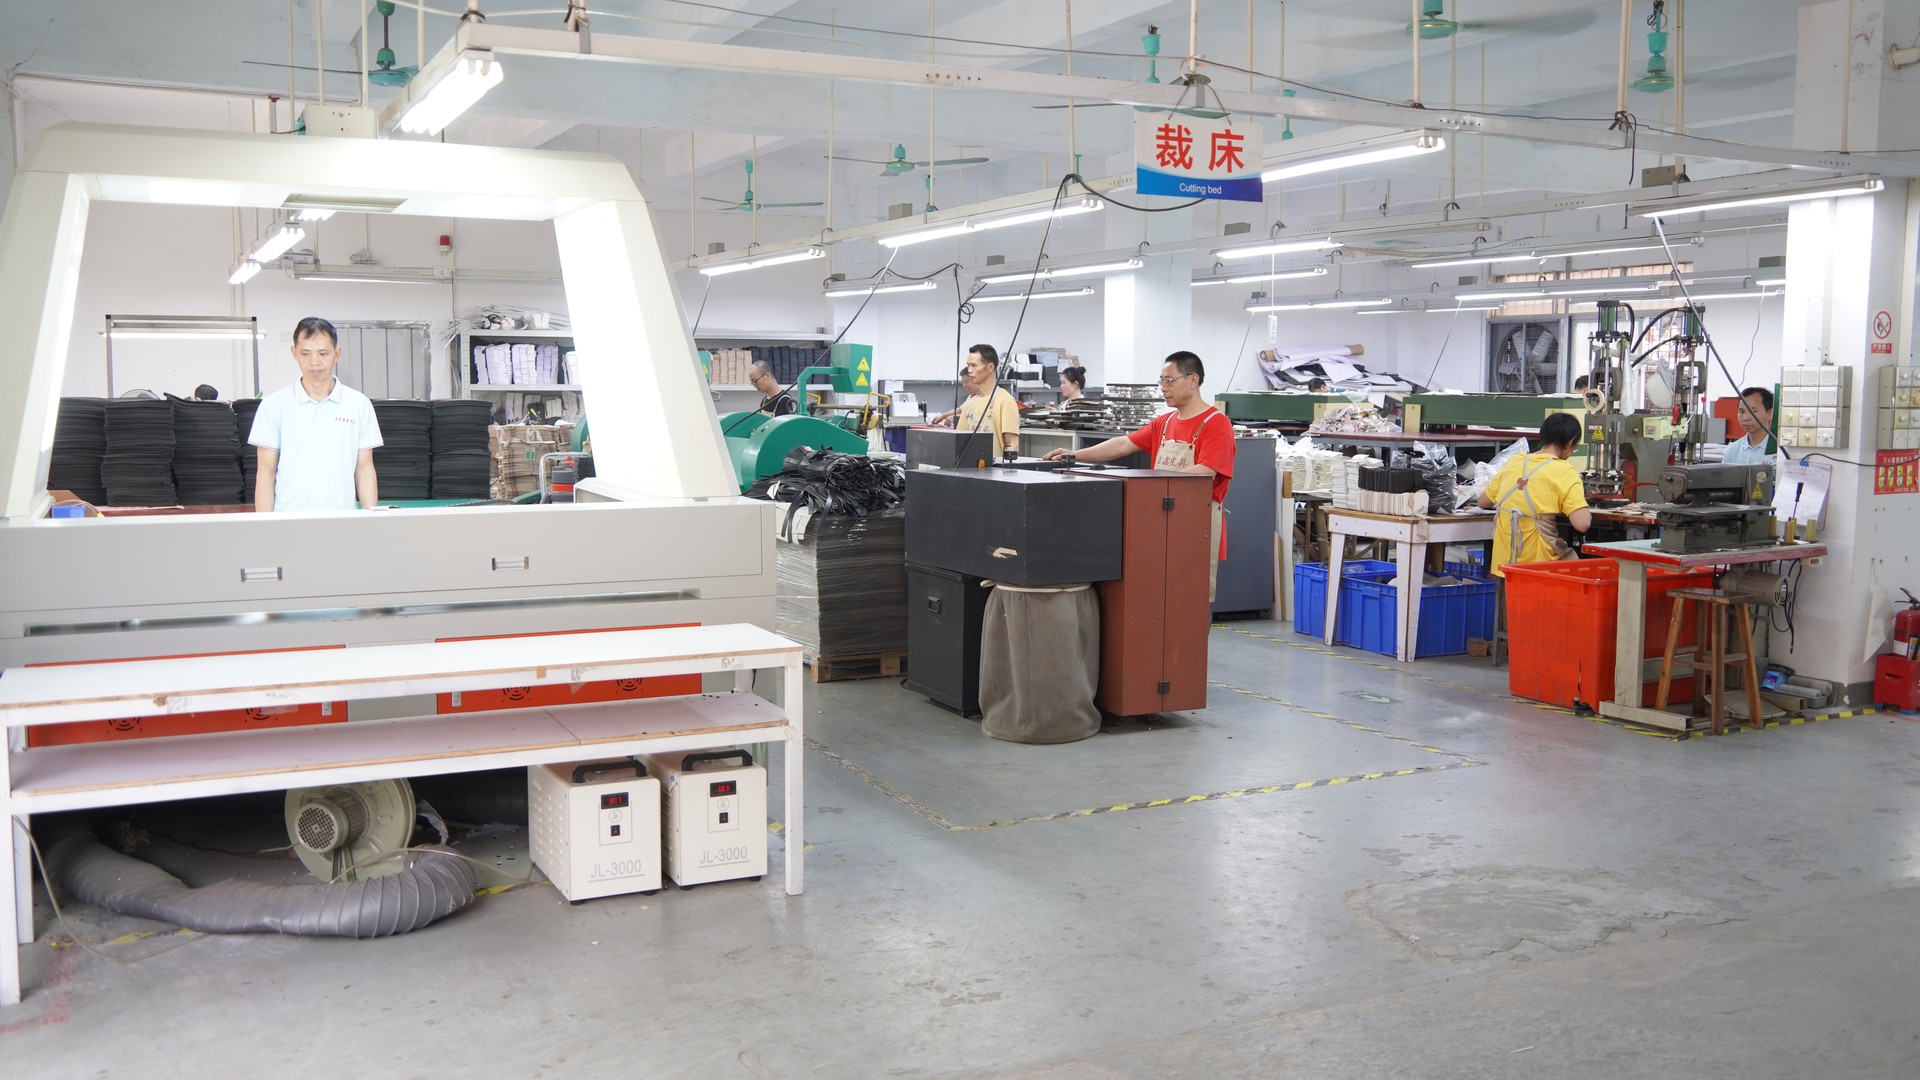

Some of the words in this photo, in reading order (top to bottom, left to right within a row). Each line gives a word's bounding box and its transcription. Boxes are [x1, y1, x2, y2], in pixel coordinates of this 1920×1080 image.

[1156, 123, 1245, 173] 裁床
[1179, 182, 1206, 195] Cutting
[1208, 184, 1222, 194] bed
[700, 847, 747, 864] JL-3000
[591, 860, 641, 878] JL-3000
